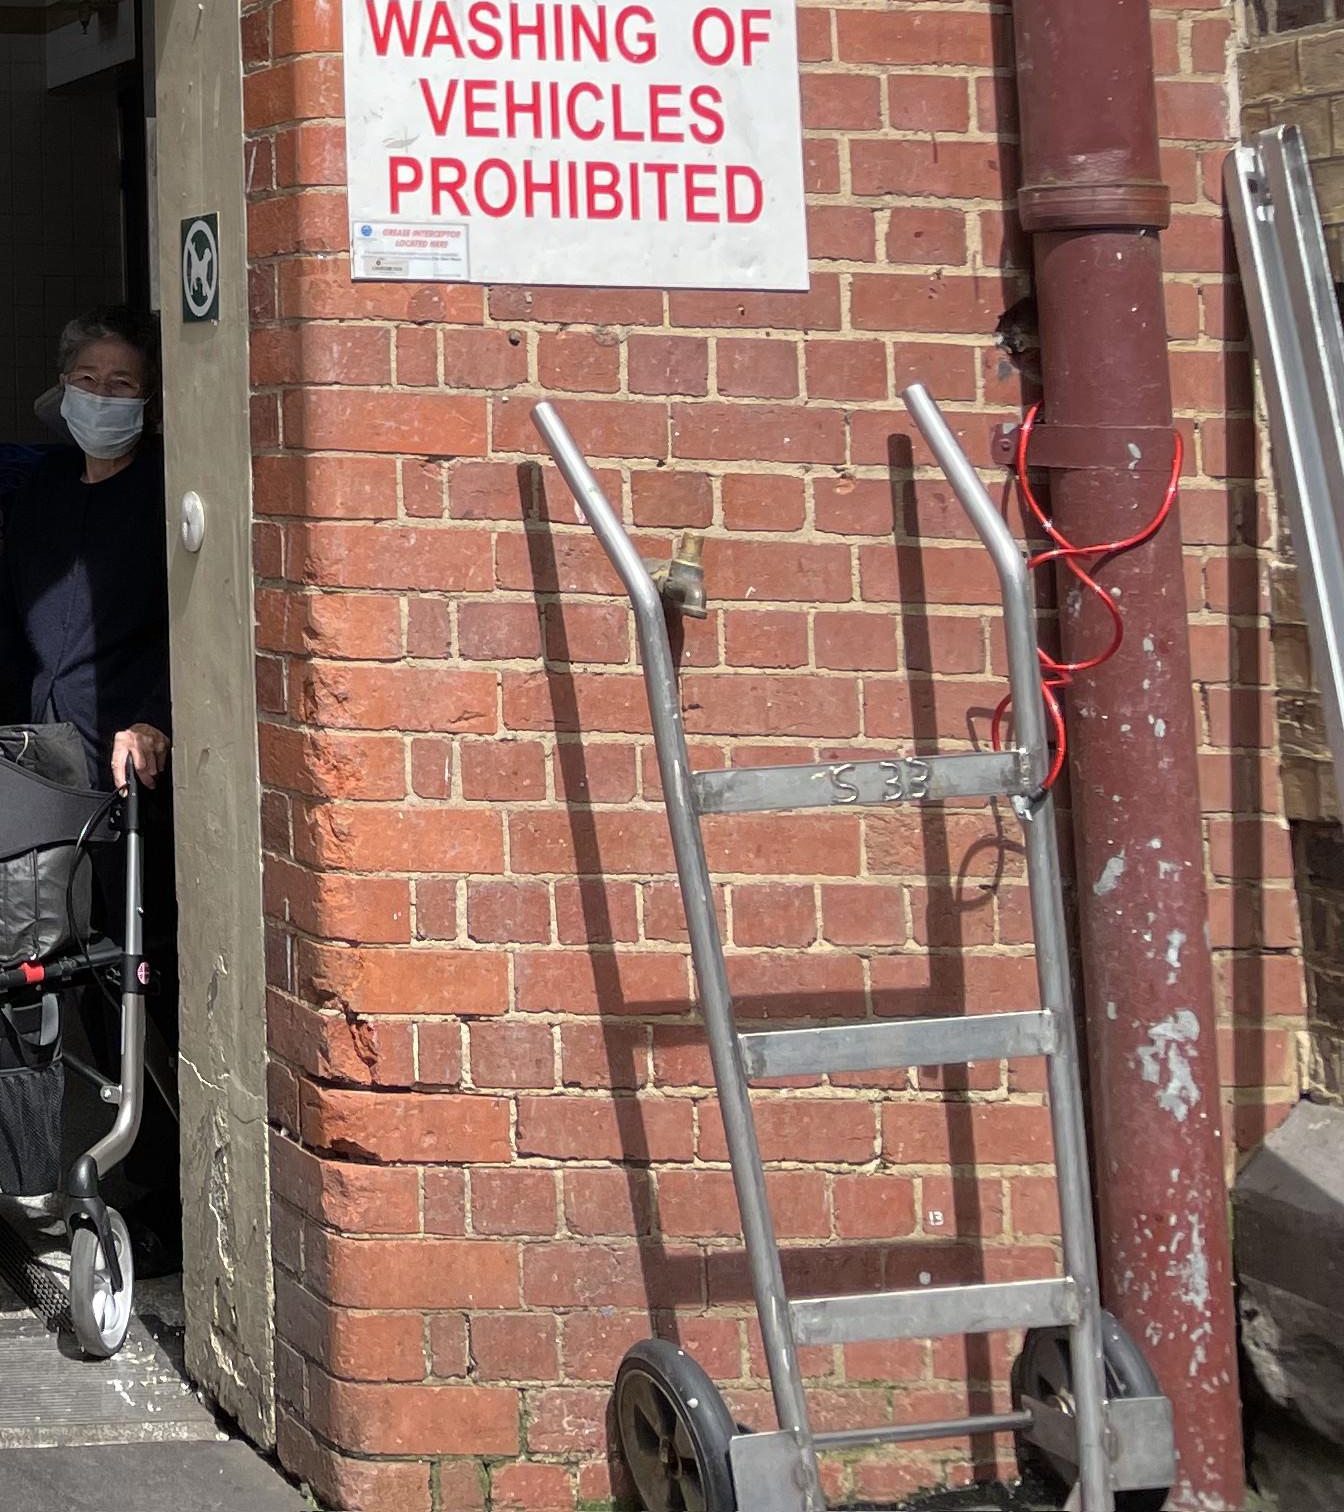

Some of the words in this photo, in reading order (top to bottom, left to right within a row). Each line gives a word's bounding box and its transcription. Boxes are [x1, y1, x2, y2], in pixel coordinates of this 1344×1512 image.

[692, 6, 772, 67] OF
[420, 78, 726, 146] VEHICLES
[388, 156, 764, 223] PROHIBITED
[830, 763, 859, 803] S
